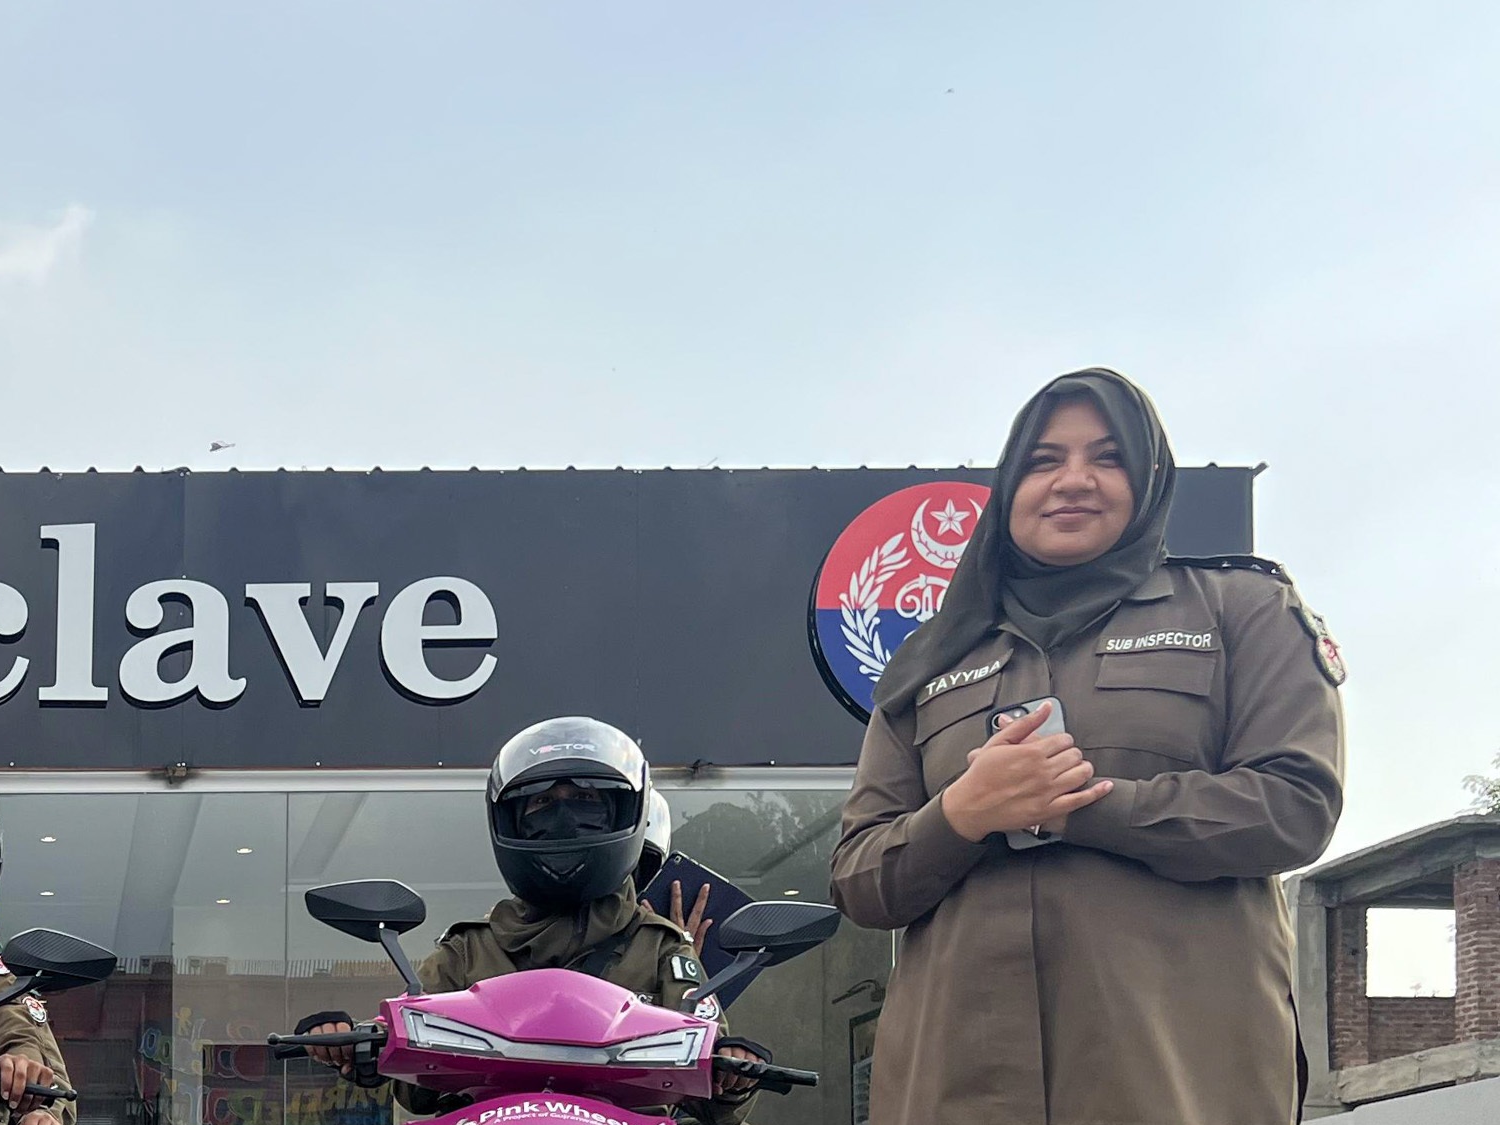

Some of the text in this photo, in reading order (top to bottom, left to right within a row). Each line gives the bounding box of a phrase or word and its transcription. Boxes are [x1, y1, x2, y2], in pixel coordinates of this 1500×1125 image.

[1106, 632, 1212, 651] SUB INSPECTOR
[925, 660, 1001, 696] TAYYIBA
[479, 1101, 540, 1124] Pink
